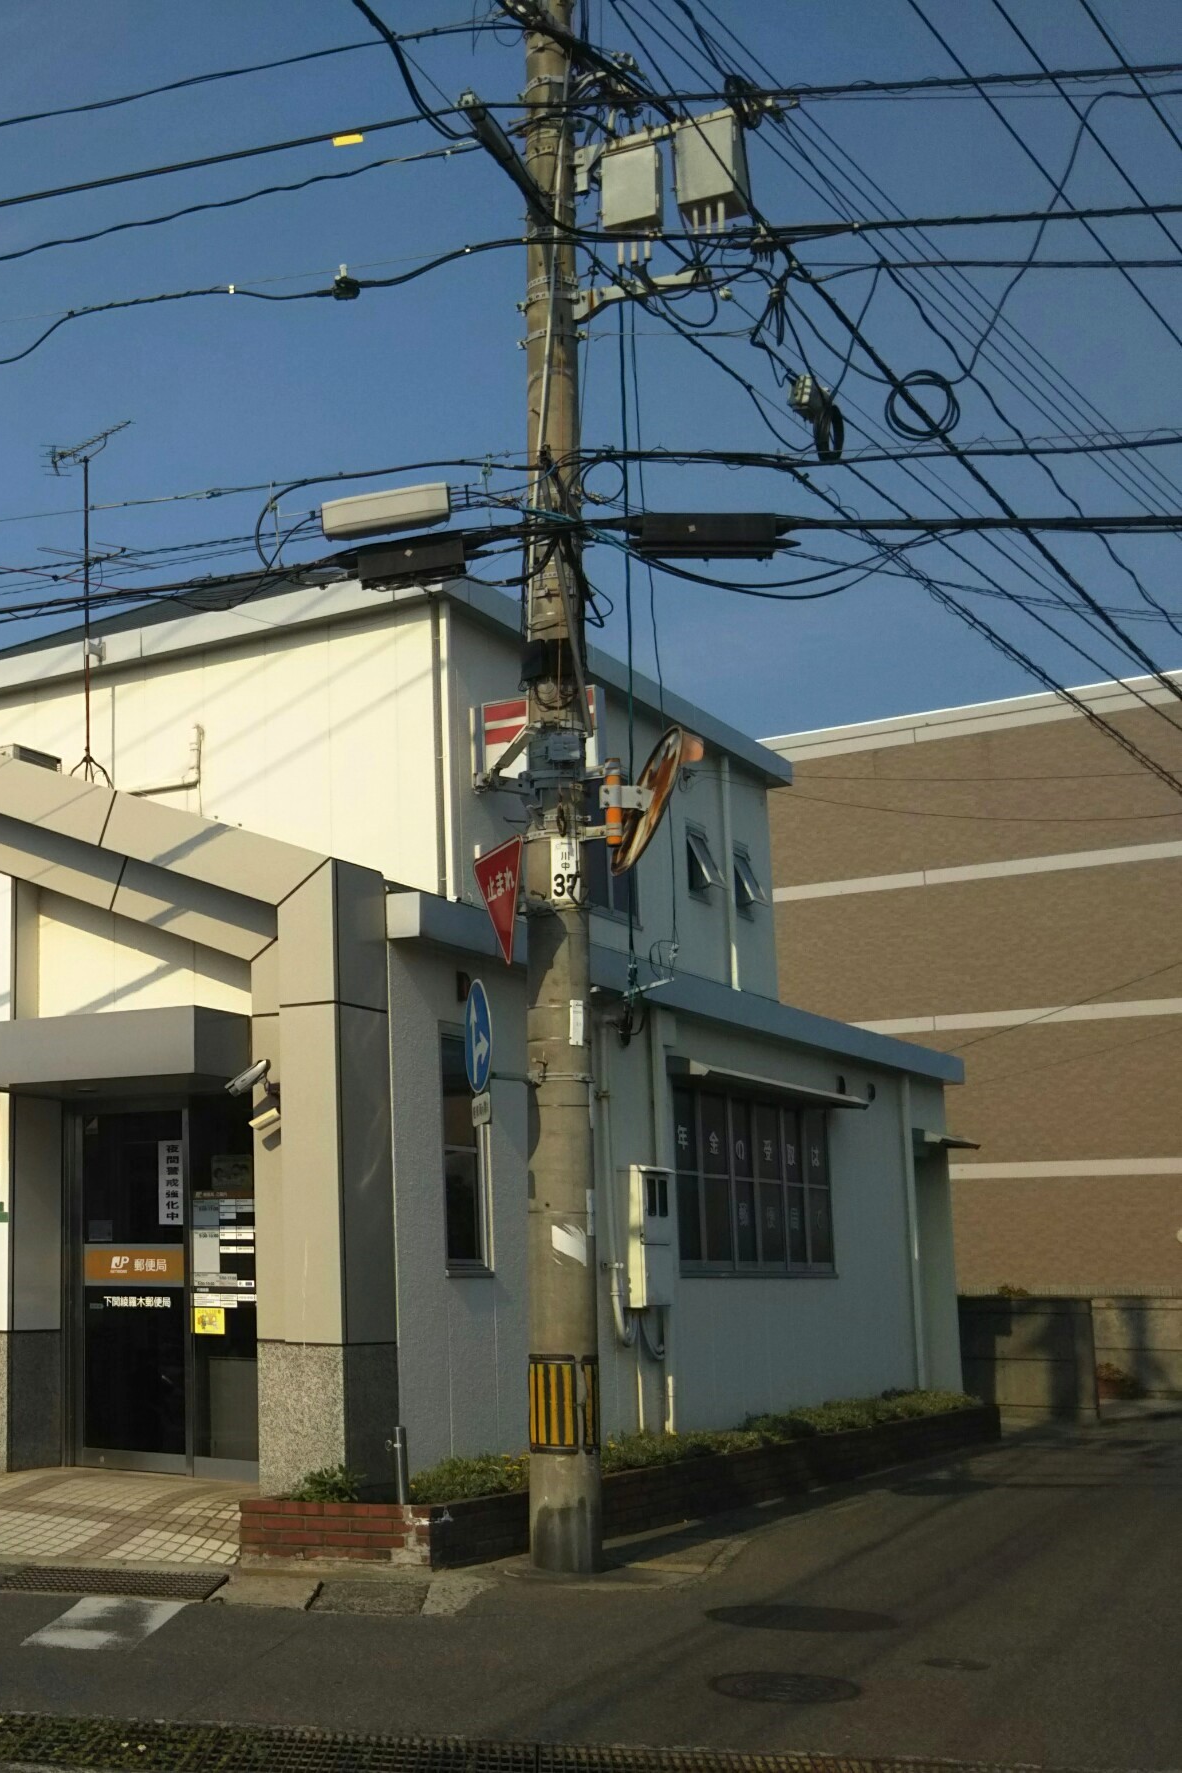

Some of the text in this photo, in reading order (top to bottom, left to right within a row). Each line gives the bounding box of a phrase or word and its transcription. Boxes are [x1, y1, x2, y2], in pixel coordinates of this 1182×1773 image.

[486, 866, 515, 903] 止まれ
[165, 1144, 180, 1221] 夜間警戒強化中
[133, 1258, 167, 1272] 郵便局
[103, 1296, 172, 1308] 下関綾羅木郵便局
